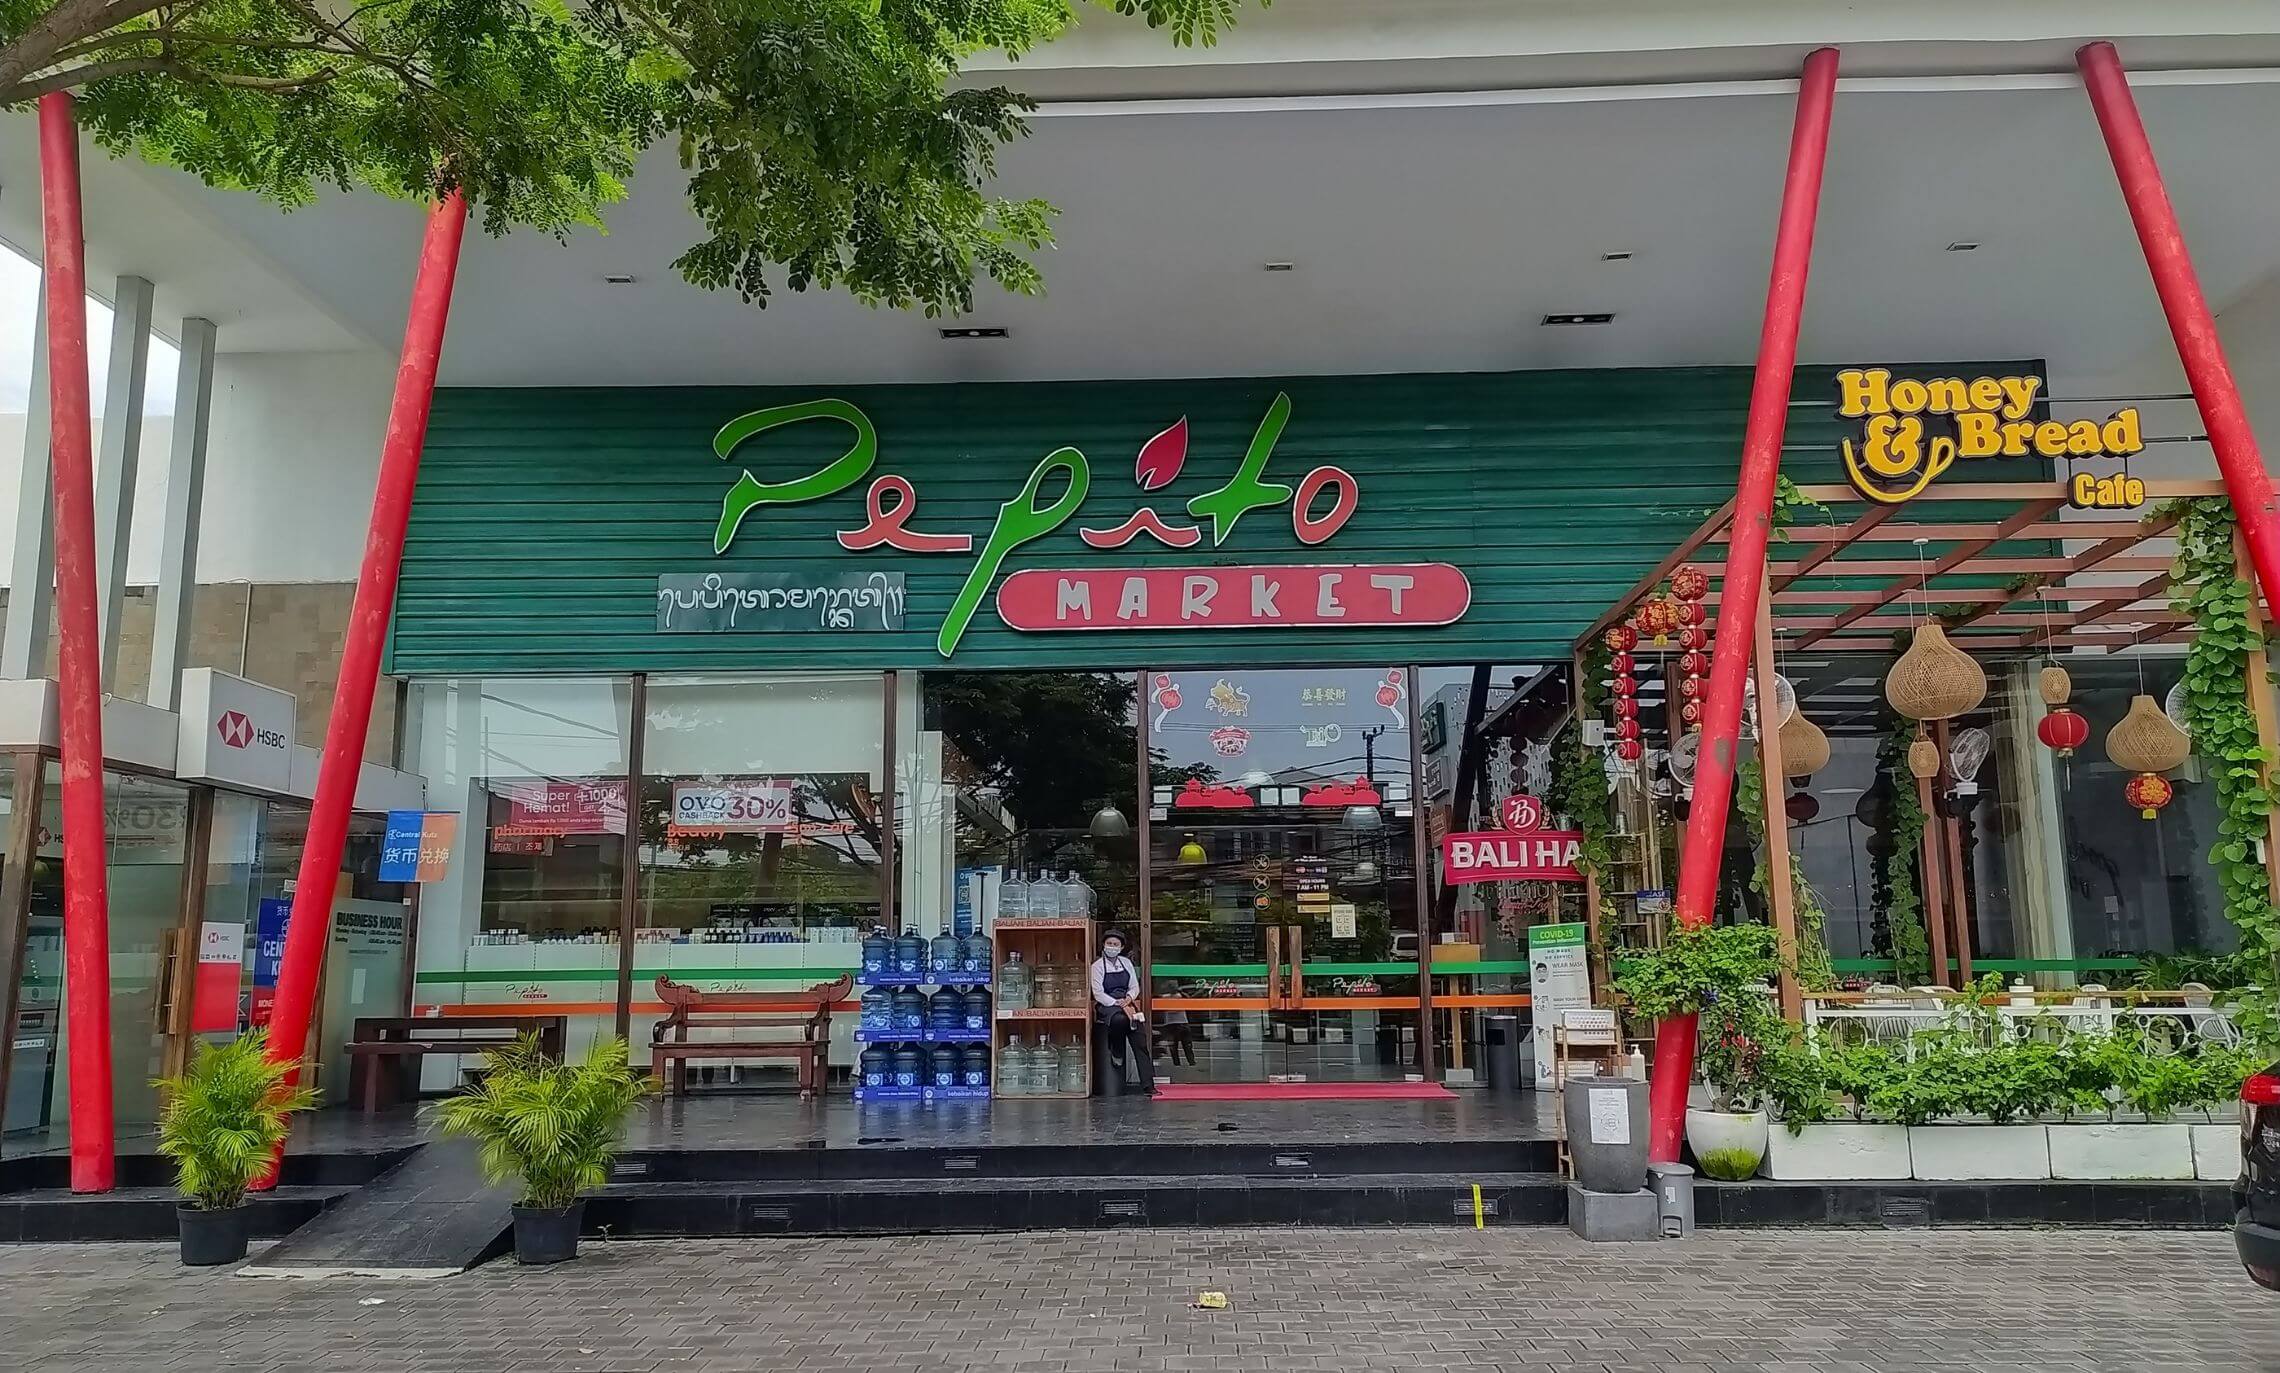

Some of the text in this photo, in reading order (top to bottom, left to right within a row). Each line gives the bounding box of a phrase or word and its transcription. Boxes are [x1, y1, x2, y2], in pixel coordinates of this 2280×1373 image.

[1836, 367, 2042, 420] Honey
[1955, 407, 2146, 458] Bread
[2073, 471, 2146, 507] Cafe
[712, 391, 1360, 658] Pepito
[1056, 573, 1415, 621] MARKET
[256, 727, 287, 750] HSBC
[532, 790, 570, 803] Super
[679, 796, 726, 812] OVO
[523, 801, 570, 814] Hemat!
[678, 811, 725, 820] CASHBACK
[727, 796, 786, 820] 30%
[395, 830, 421, 838] Central
[494, 825, 568, 840] pharmacy
[667, 824, 726, 840] Beauty
[383, 847, 449, 864] 货币兑换
[1450, 840, 1583, 869] BALI HA
[336, 911, 403, 930] BUSINESS HOUR
[995, 919, 1086, 928] BALIAN BALIAN BALIAN
[1539, 929, 1574, 940] COVID-19
[1551, 960, 1584, 969] WEAR MASK
[949, 976, 990, 984] kebaikan hidup
[1196, 978, 1236, 995] Pepito
[1332, 976, 1373, 994] Pepito
[505, 983, 543, 999] Pepito
[1026, 1009, 1056, 1017] BALIAN
[1057, 1009, 1088, 1017] BALIAN
[948, 1090, 989, 1098] kebaikan hidup
